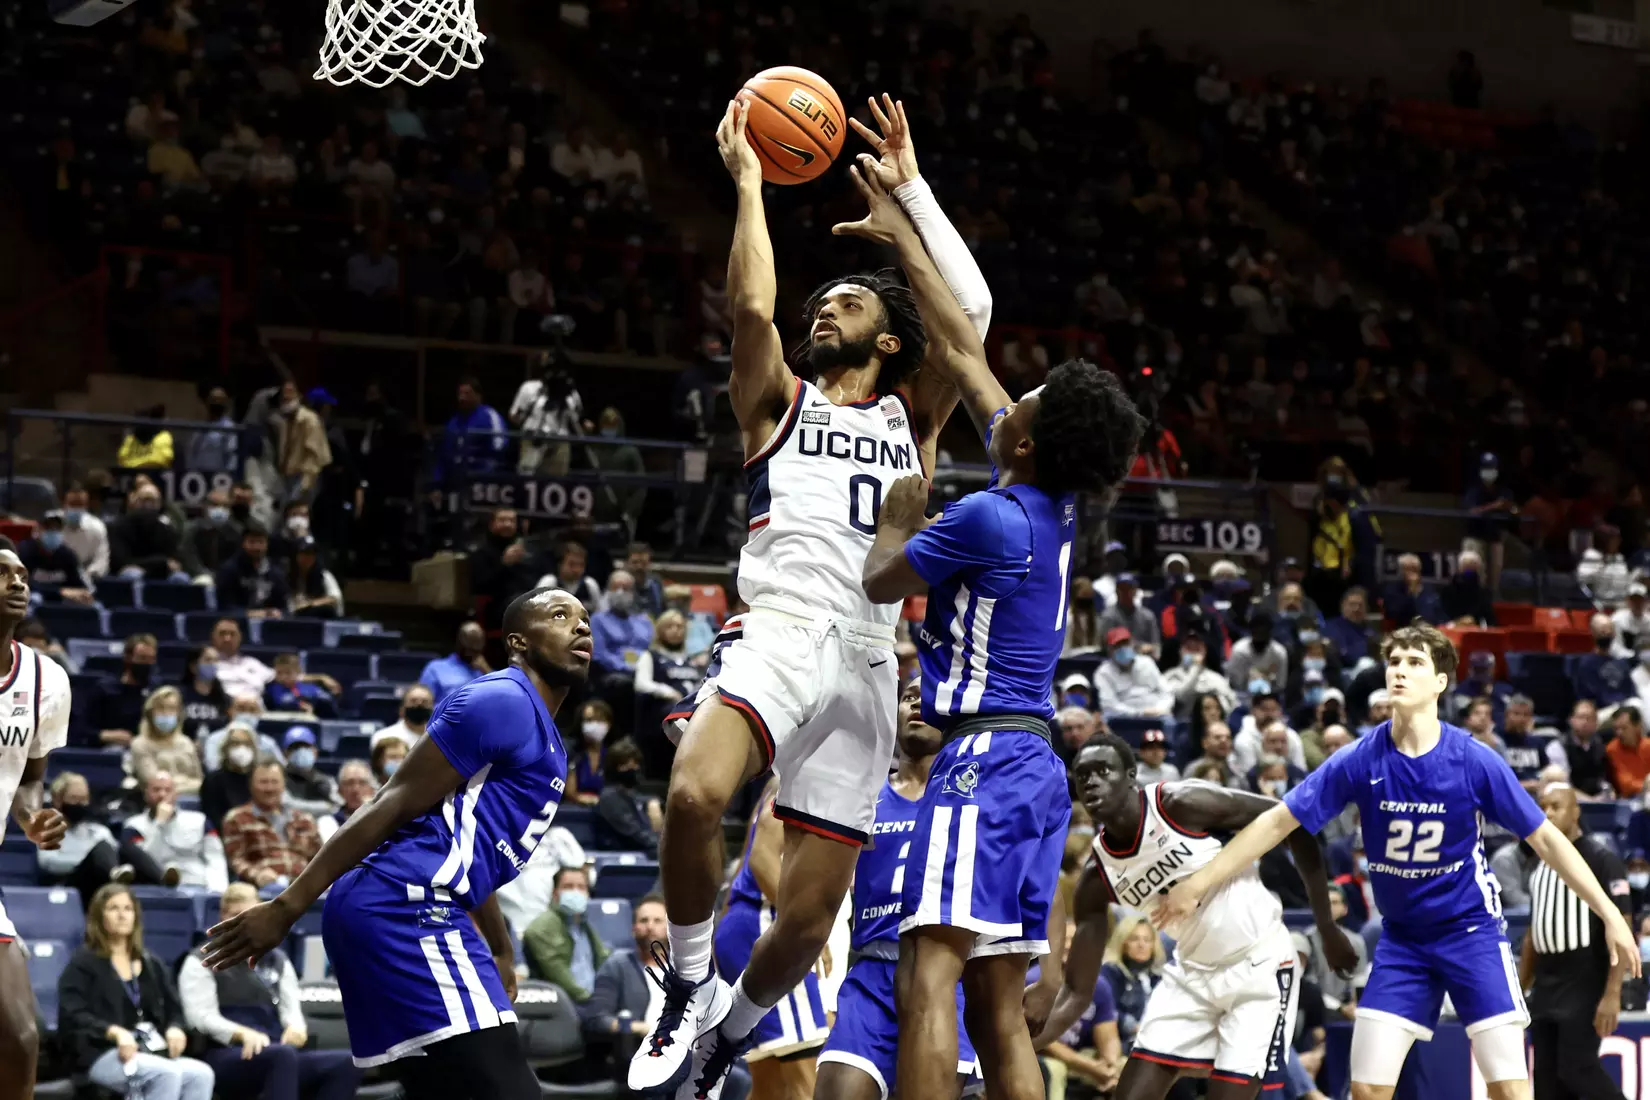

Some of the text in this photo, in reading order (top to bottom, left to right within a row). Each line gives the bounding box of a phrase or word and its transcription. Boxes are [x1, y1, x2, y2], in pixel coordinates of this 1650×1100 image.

[788, 91, 838, 142] ELITE
[798, 428, 912, 470] UCONN
[523, 480, 594, 518] 109
[849, 473, 882, 535] 0
[1157, 520, 1262, 552] SEC 109
[1055, 541, 1072, 632] 1
[1379, 800, 1447, 814] CENTRAL
[1385, 819, 1445, 862] 22
[1122, 841, 1194, 907] UCONN
